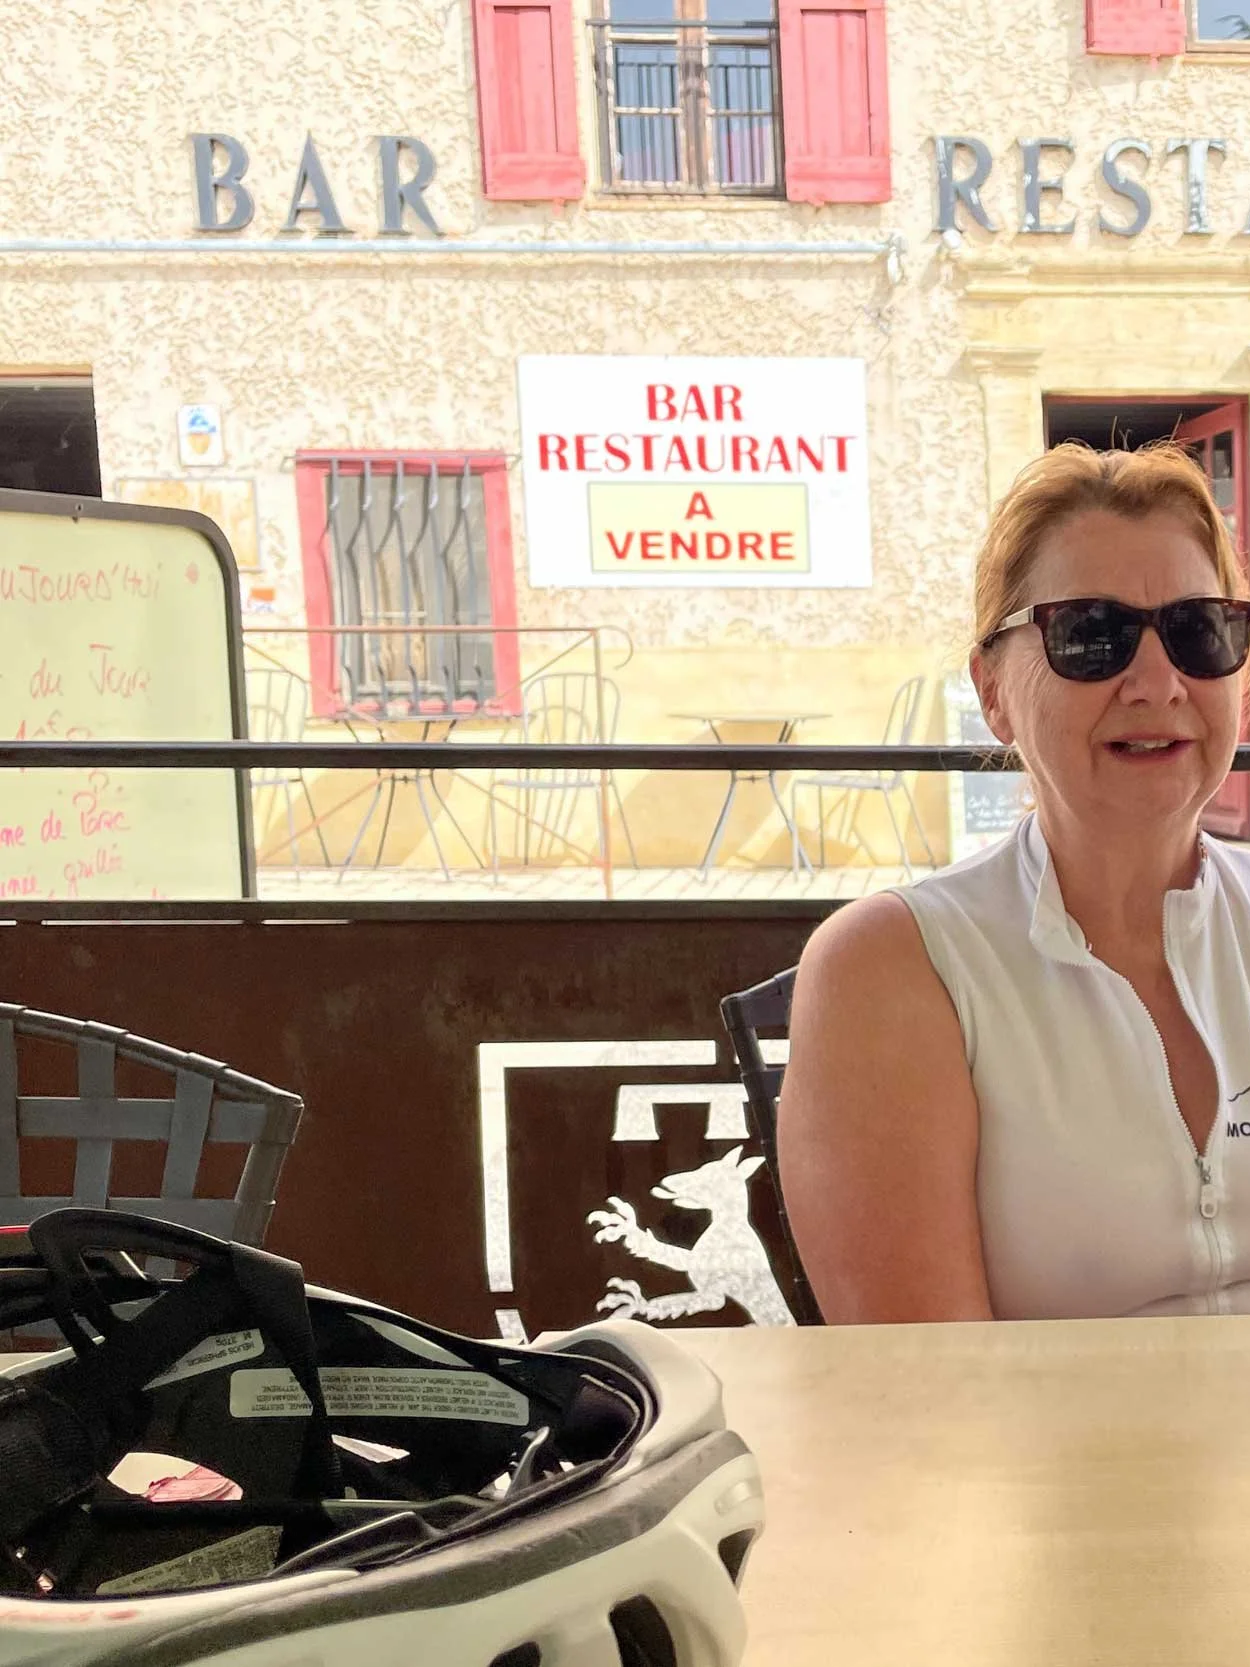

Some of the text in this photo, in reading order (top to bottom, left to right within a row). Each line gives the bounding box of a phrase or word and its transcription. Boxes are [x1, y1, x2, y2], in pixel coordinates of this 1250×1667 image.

[190, 130, 445, 237] BAR
[646, 383, 743, 422] BAR
[538, 433, 857, 472] RESTAURANT
[685, 491, 714, 520] A
[605, 531, 795, 560] VENDRE
